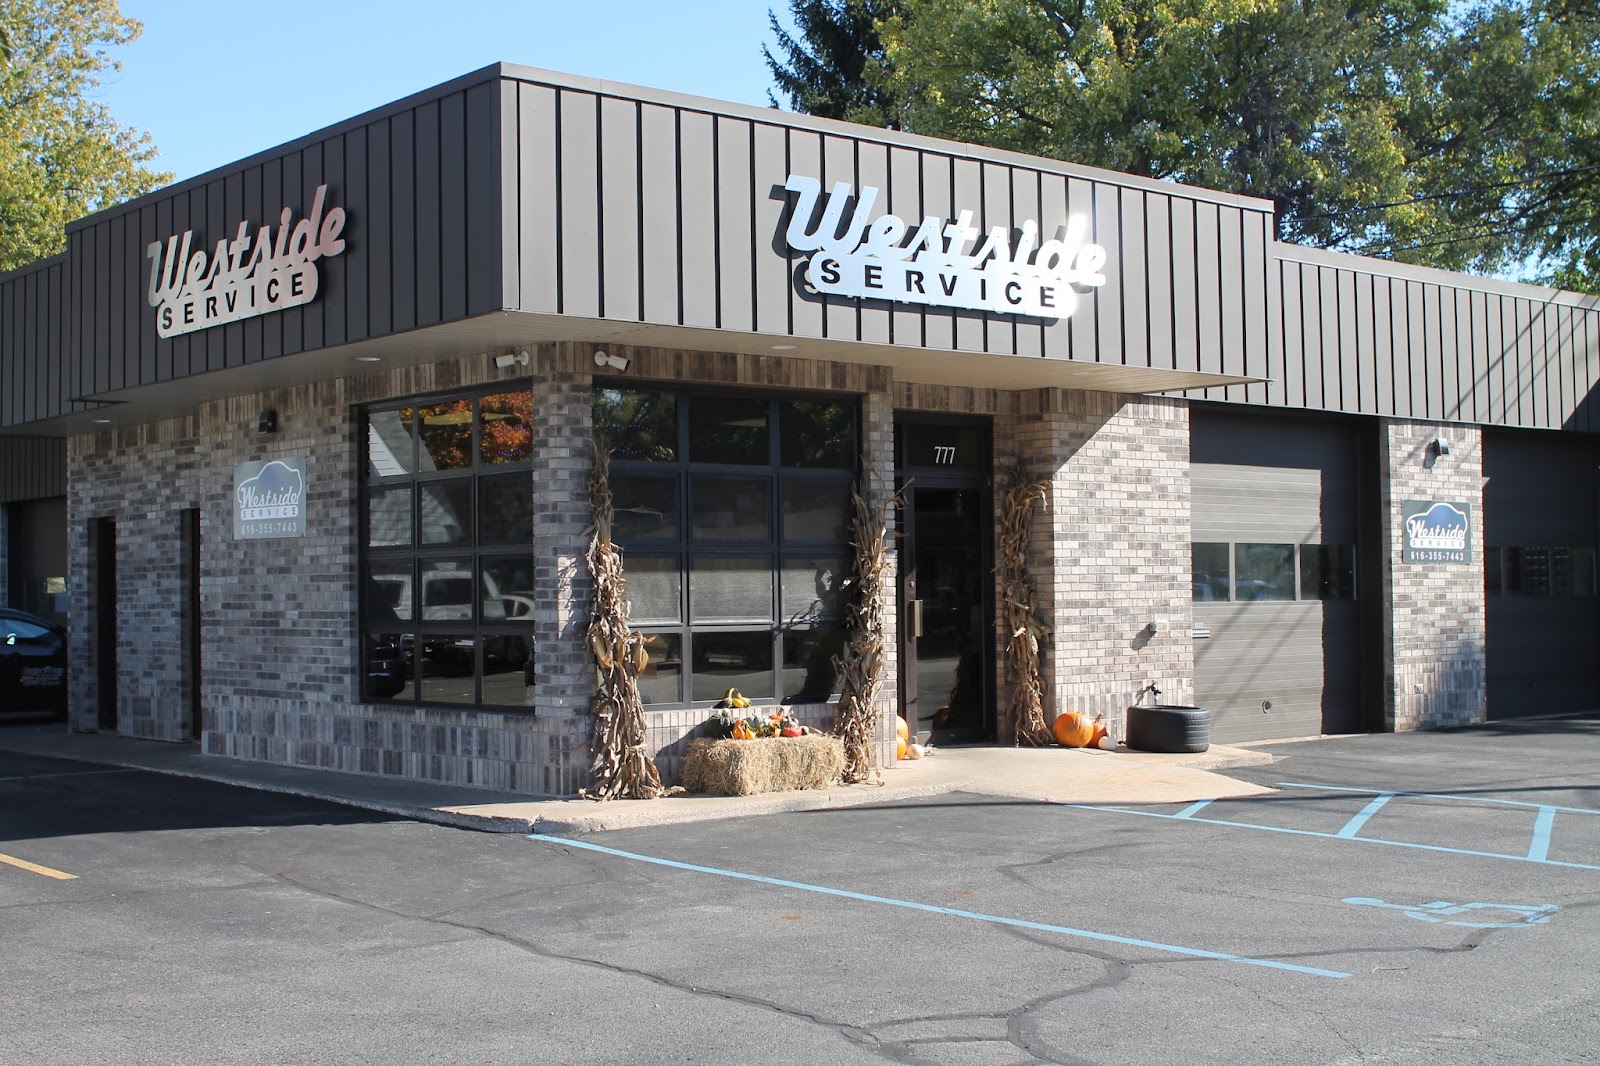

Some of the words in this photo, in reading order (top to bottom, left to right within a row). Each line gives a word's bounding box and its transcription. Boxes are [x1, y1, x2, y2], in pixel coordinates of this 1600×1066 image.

[785, 174, 1107, 287] Westside
[147, 184, 346, 307] Westside
[820, 258, 1056, 308] SERVICE
[162, 272, 304, 330] SERVICE
[934, 446, 956, 464] 777
[240, 486, 298, 508] Westside
[242, 507, 296, 519] SERVICE
[241, 522, 297, 535] 616-355-7443
[1409, 520, 1464, 539] Westside
[1412, 540, 1463, 548] SERVICE
[1410, 551, 1464, 561] 616-355-7443
